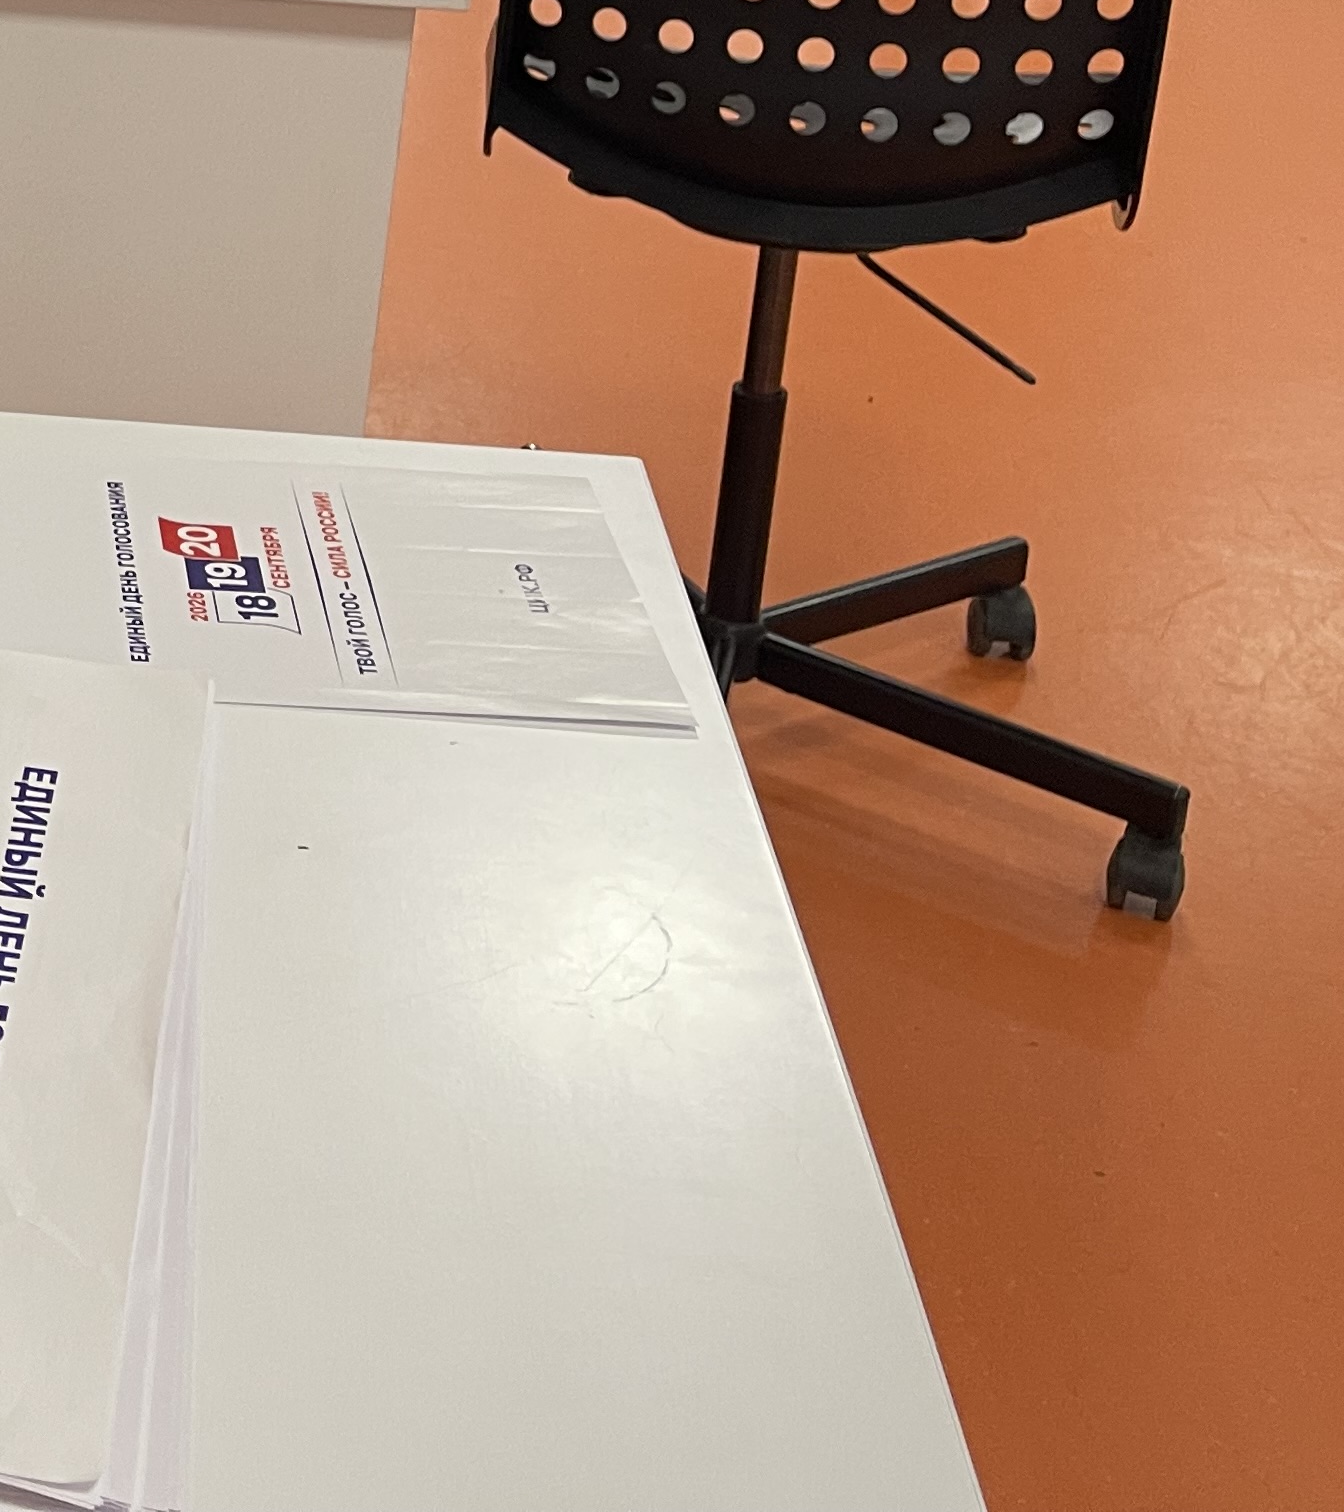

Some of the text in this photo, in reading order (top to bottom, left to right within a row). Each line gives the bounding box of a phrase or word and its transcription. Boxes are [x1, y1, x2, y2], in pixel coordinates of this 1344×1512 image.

[107, 481, 150, 663] ЕДИНЫЙ ДЕНЬ ГОЛОСОВАНИЯ
[177, 526, 279, 620] 18 19 20
[260, 526, 291, 589] СЕНТЯБРЯ
[327, 545, 352, 580] СИЛА
[187, 592, 209, 622] 2026
[339, 592, 369, 637] ГОЛОС
[347, 639, 379, 676] ТВОЙ
